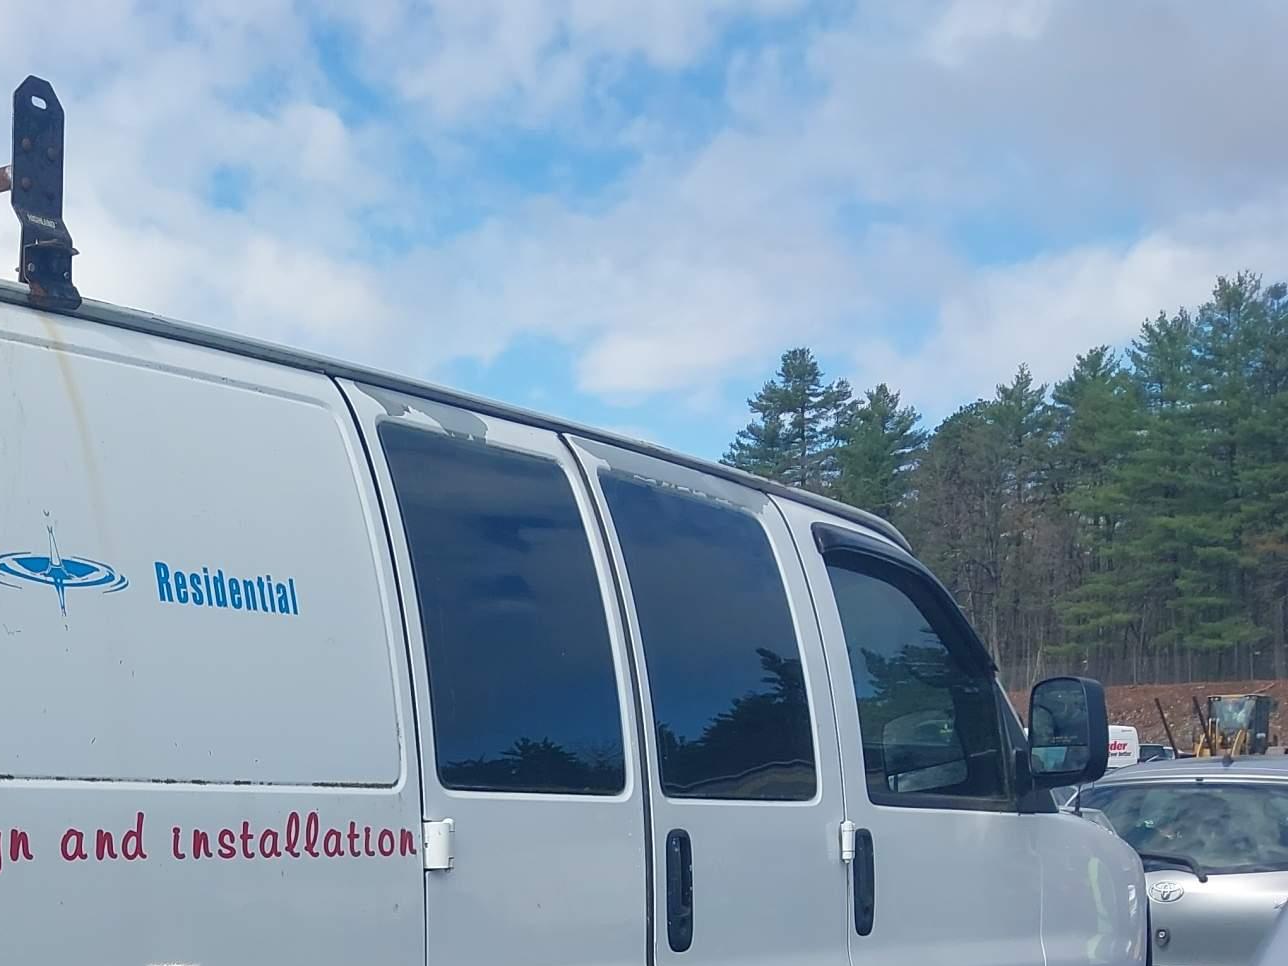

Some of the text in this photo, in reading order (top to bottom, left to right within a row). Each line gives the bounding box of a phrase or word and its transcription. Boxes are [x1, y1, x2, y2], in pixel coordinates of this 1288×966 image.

[154, 560, 300, 615] Residential
[1107, 740, 1128, 752] der
[60, 811, 147, 860] and
[172, 811, 417, 859] installation
